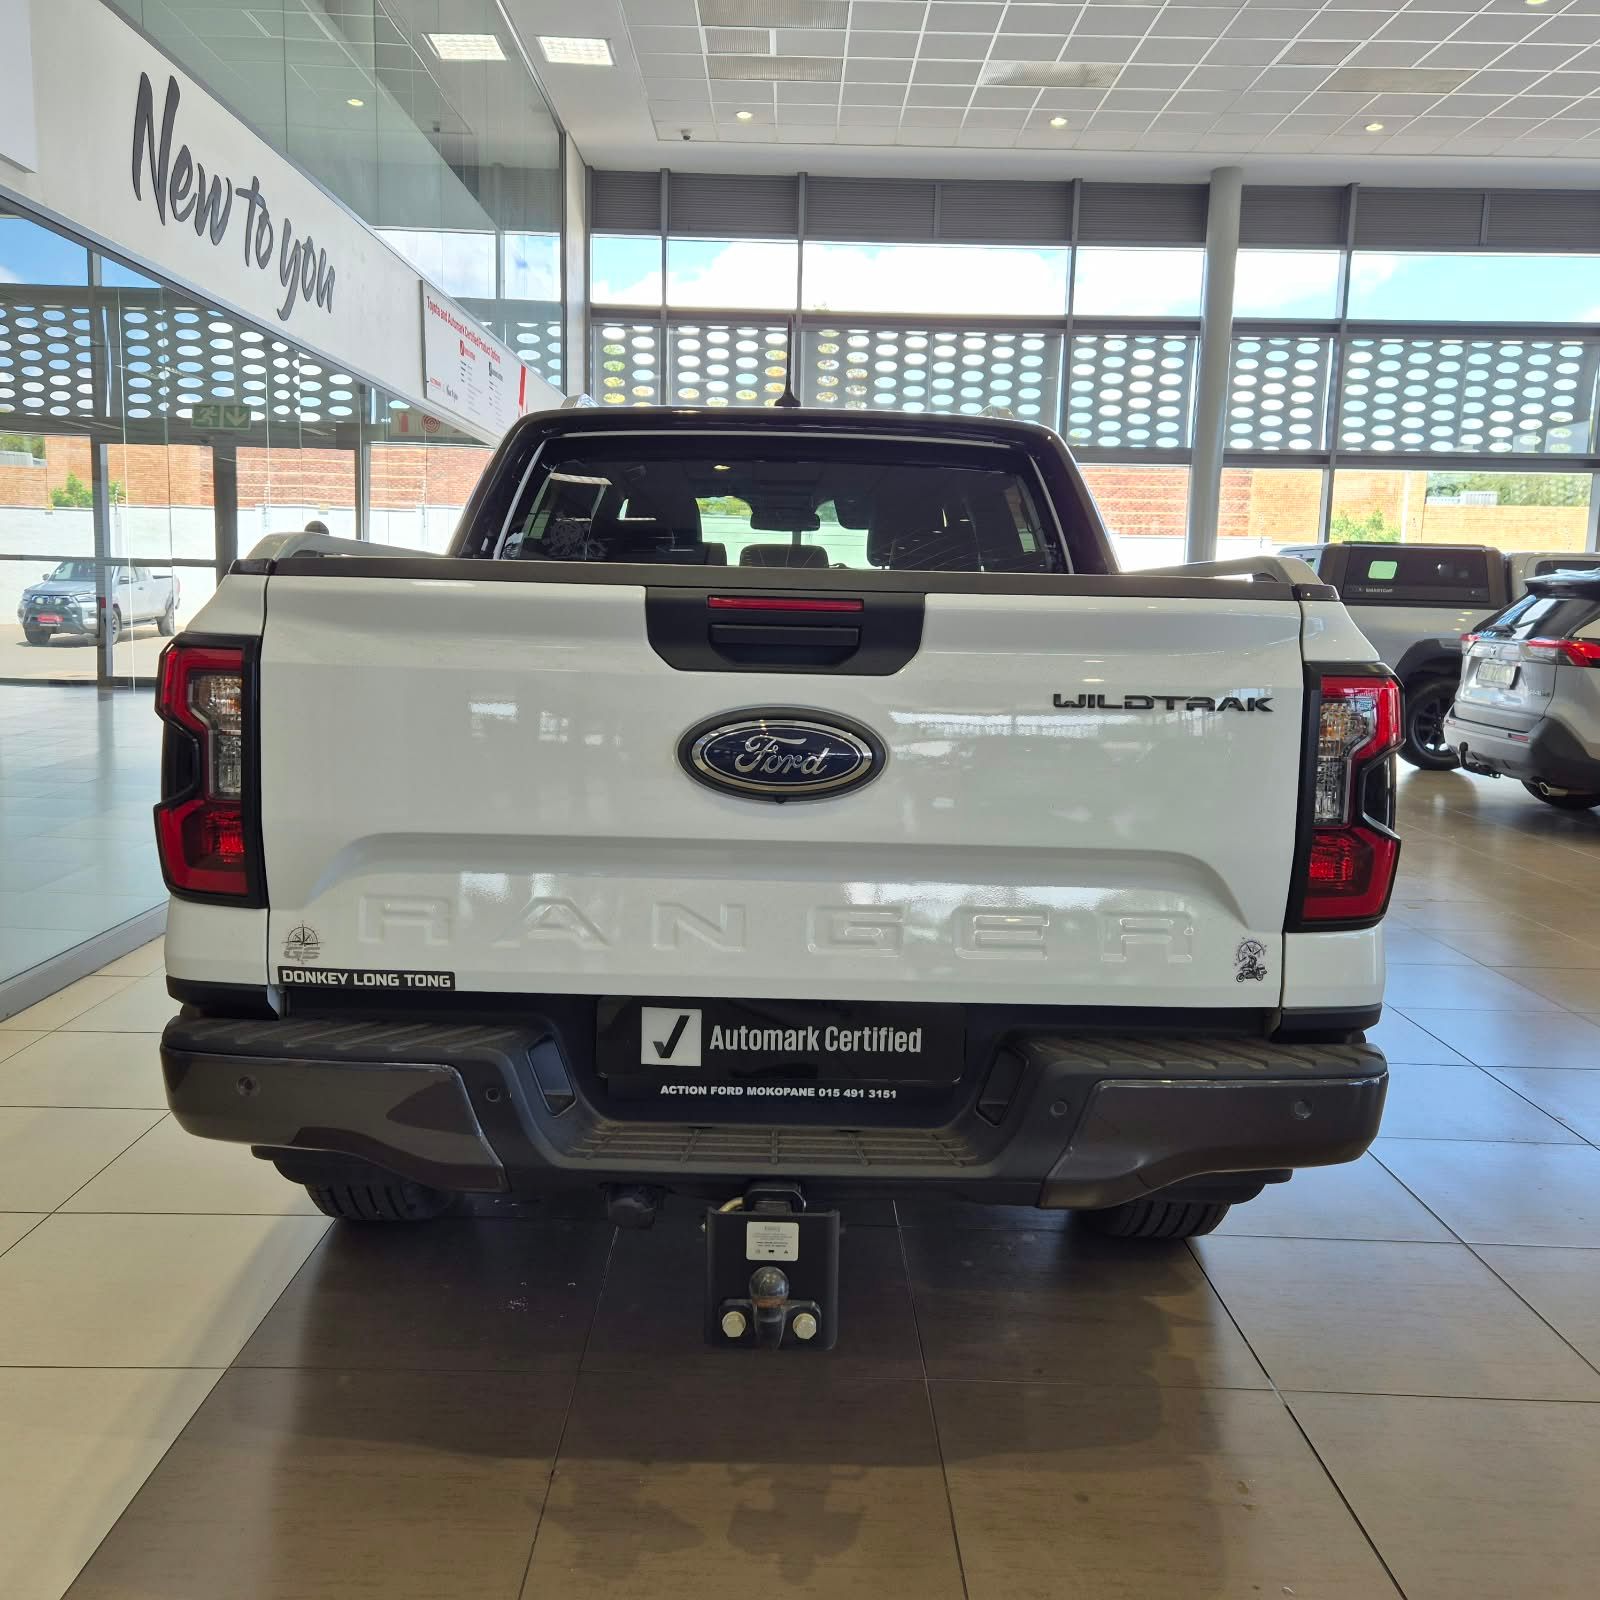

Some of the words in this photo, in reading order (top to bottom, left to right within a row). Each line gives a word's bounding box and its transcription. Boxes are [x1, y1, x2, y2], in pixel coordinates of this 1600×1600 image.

[132, 72, 232, 246] New
[235, 176, 274, 270] to
[276, 218, 336, 322] you
[1053, 693, 1274, 713] WILDTRAK
[734, 734, 829, 775] Ford
[357, 893, 1195, 964] RANGER
[282, 969, 349, 986] DONKEY
[353, 972, 400, 987] LONG
[404, 974, 451, 988] TONG
[709, 1024, 820, 1052] Automark
[824, 1026, 922, 1053] Certified
[660, 1085, 707, 1096] ACTION
[710, 1086, 744, 1096] FORD
[747, 1086, 815, 1097] MOKOPANE
[818, 1087, 843, 1098] 015
[843, 1088, 865, 1098] 491
[868, 1088, 898, 1099] 3151
